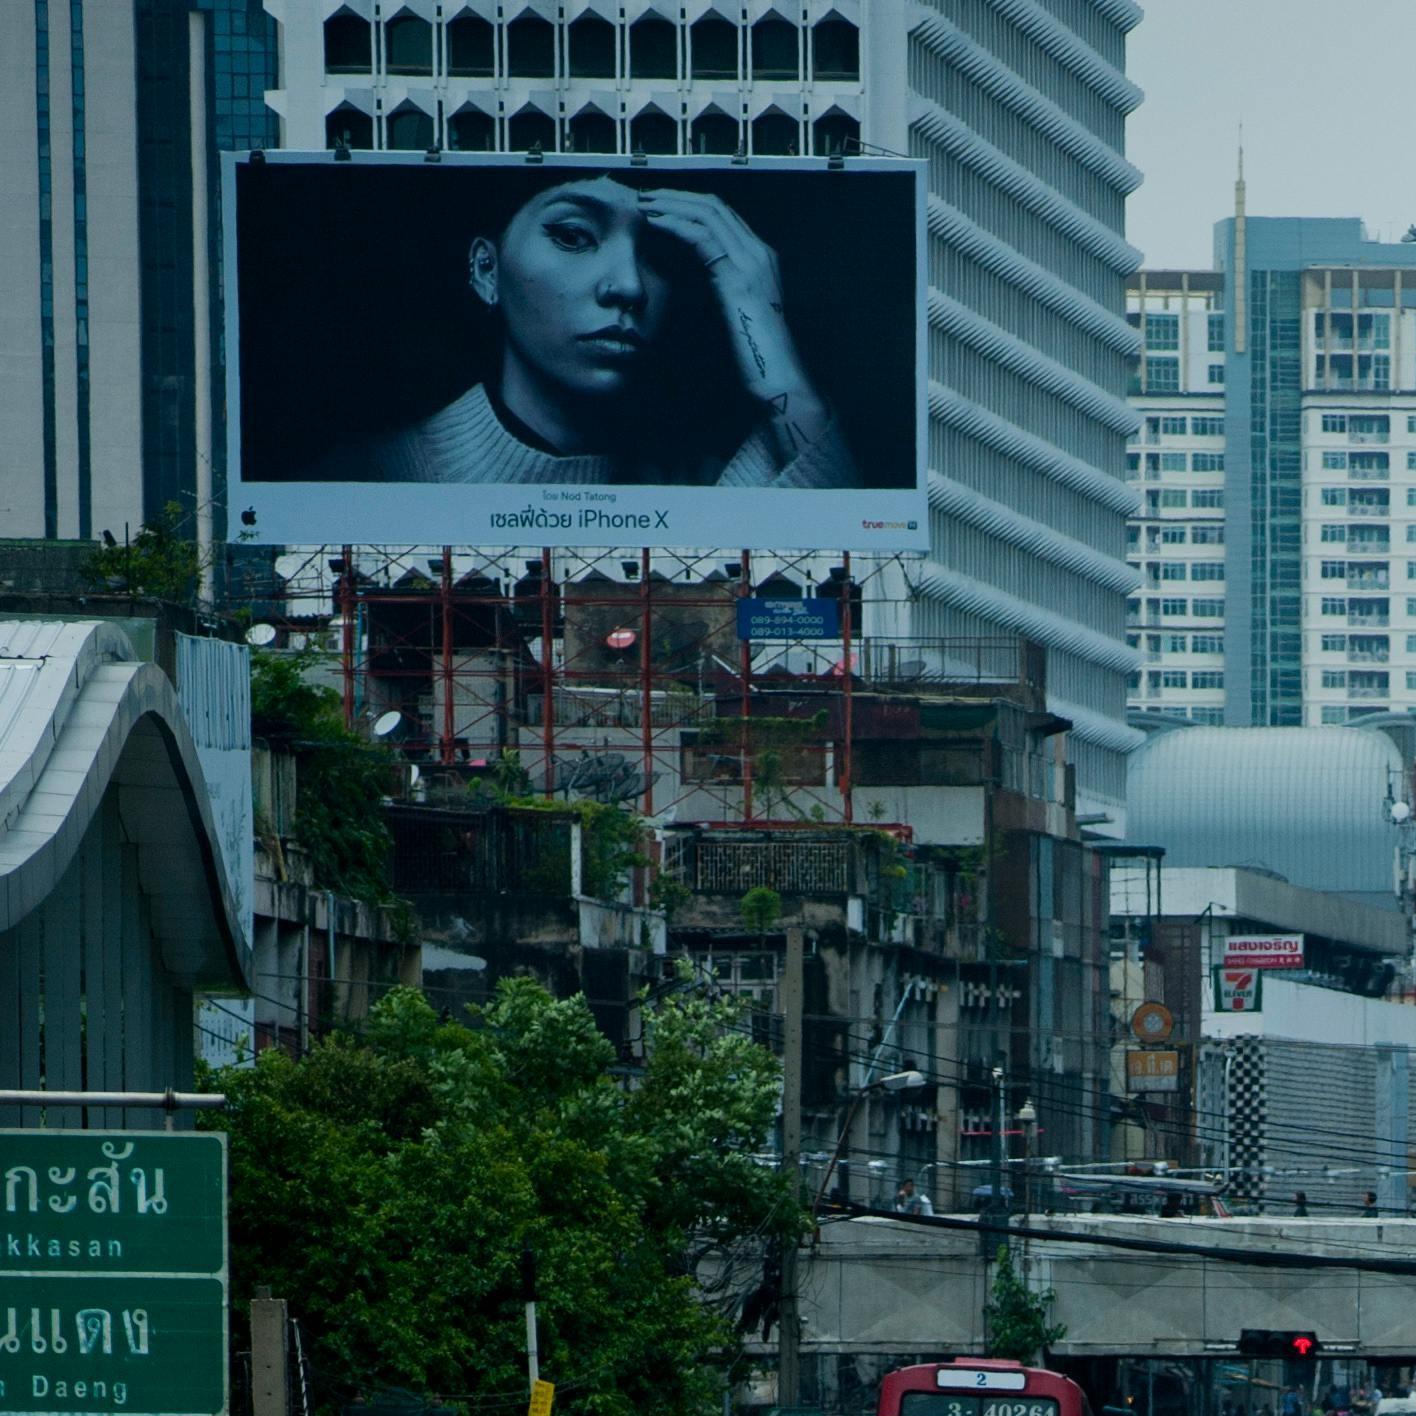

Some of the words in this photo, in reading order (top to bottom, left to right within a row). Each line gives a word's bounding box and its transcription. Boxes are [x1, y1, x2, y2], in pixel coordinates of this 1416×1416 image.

[561, 492, 581, 502] Nod
[584, 492, 616, 503] Tatong
[579, 509, 650, 528] iPhone
[654, 510, 669, 529] X
[7, 1233, 122, 1257] kkasan
[32, 1375, 127, 1405] Daeng
[976, 1373, 988, 1387] 2
